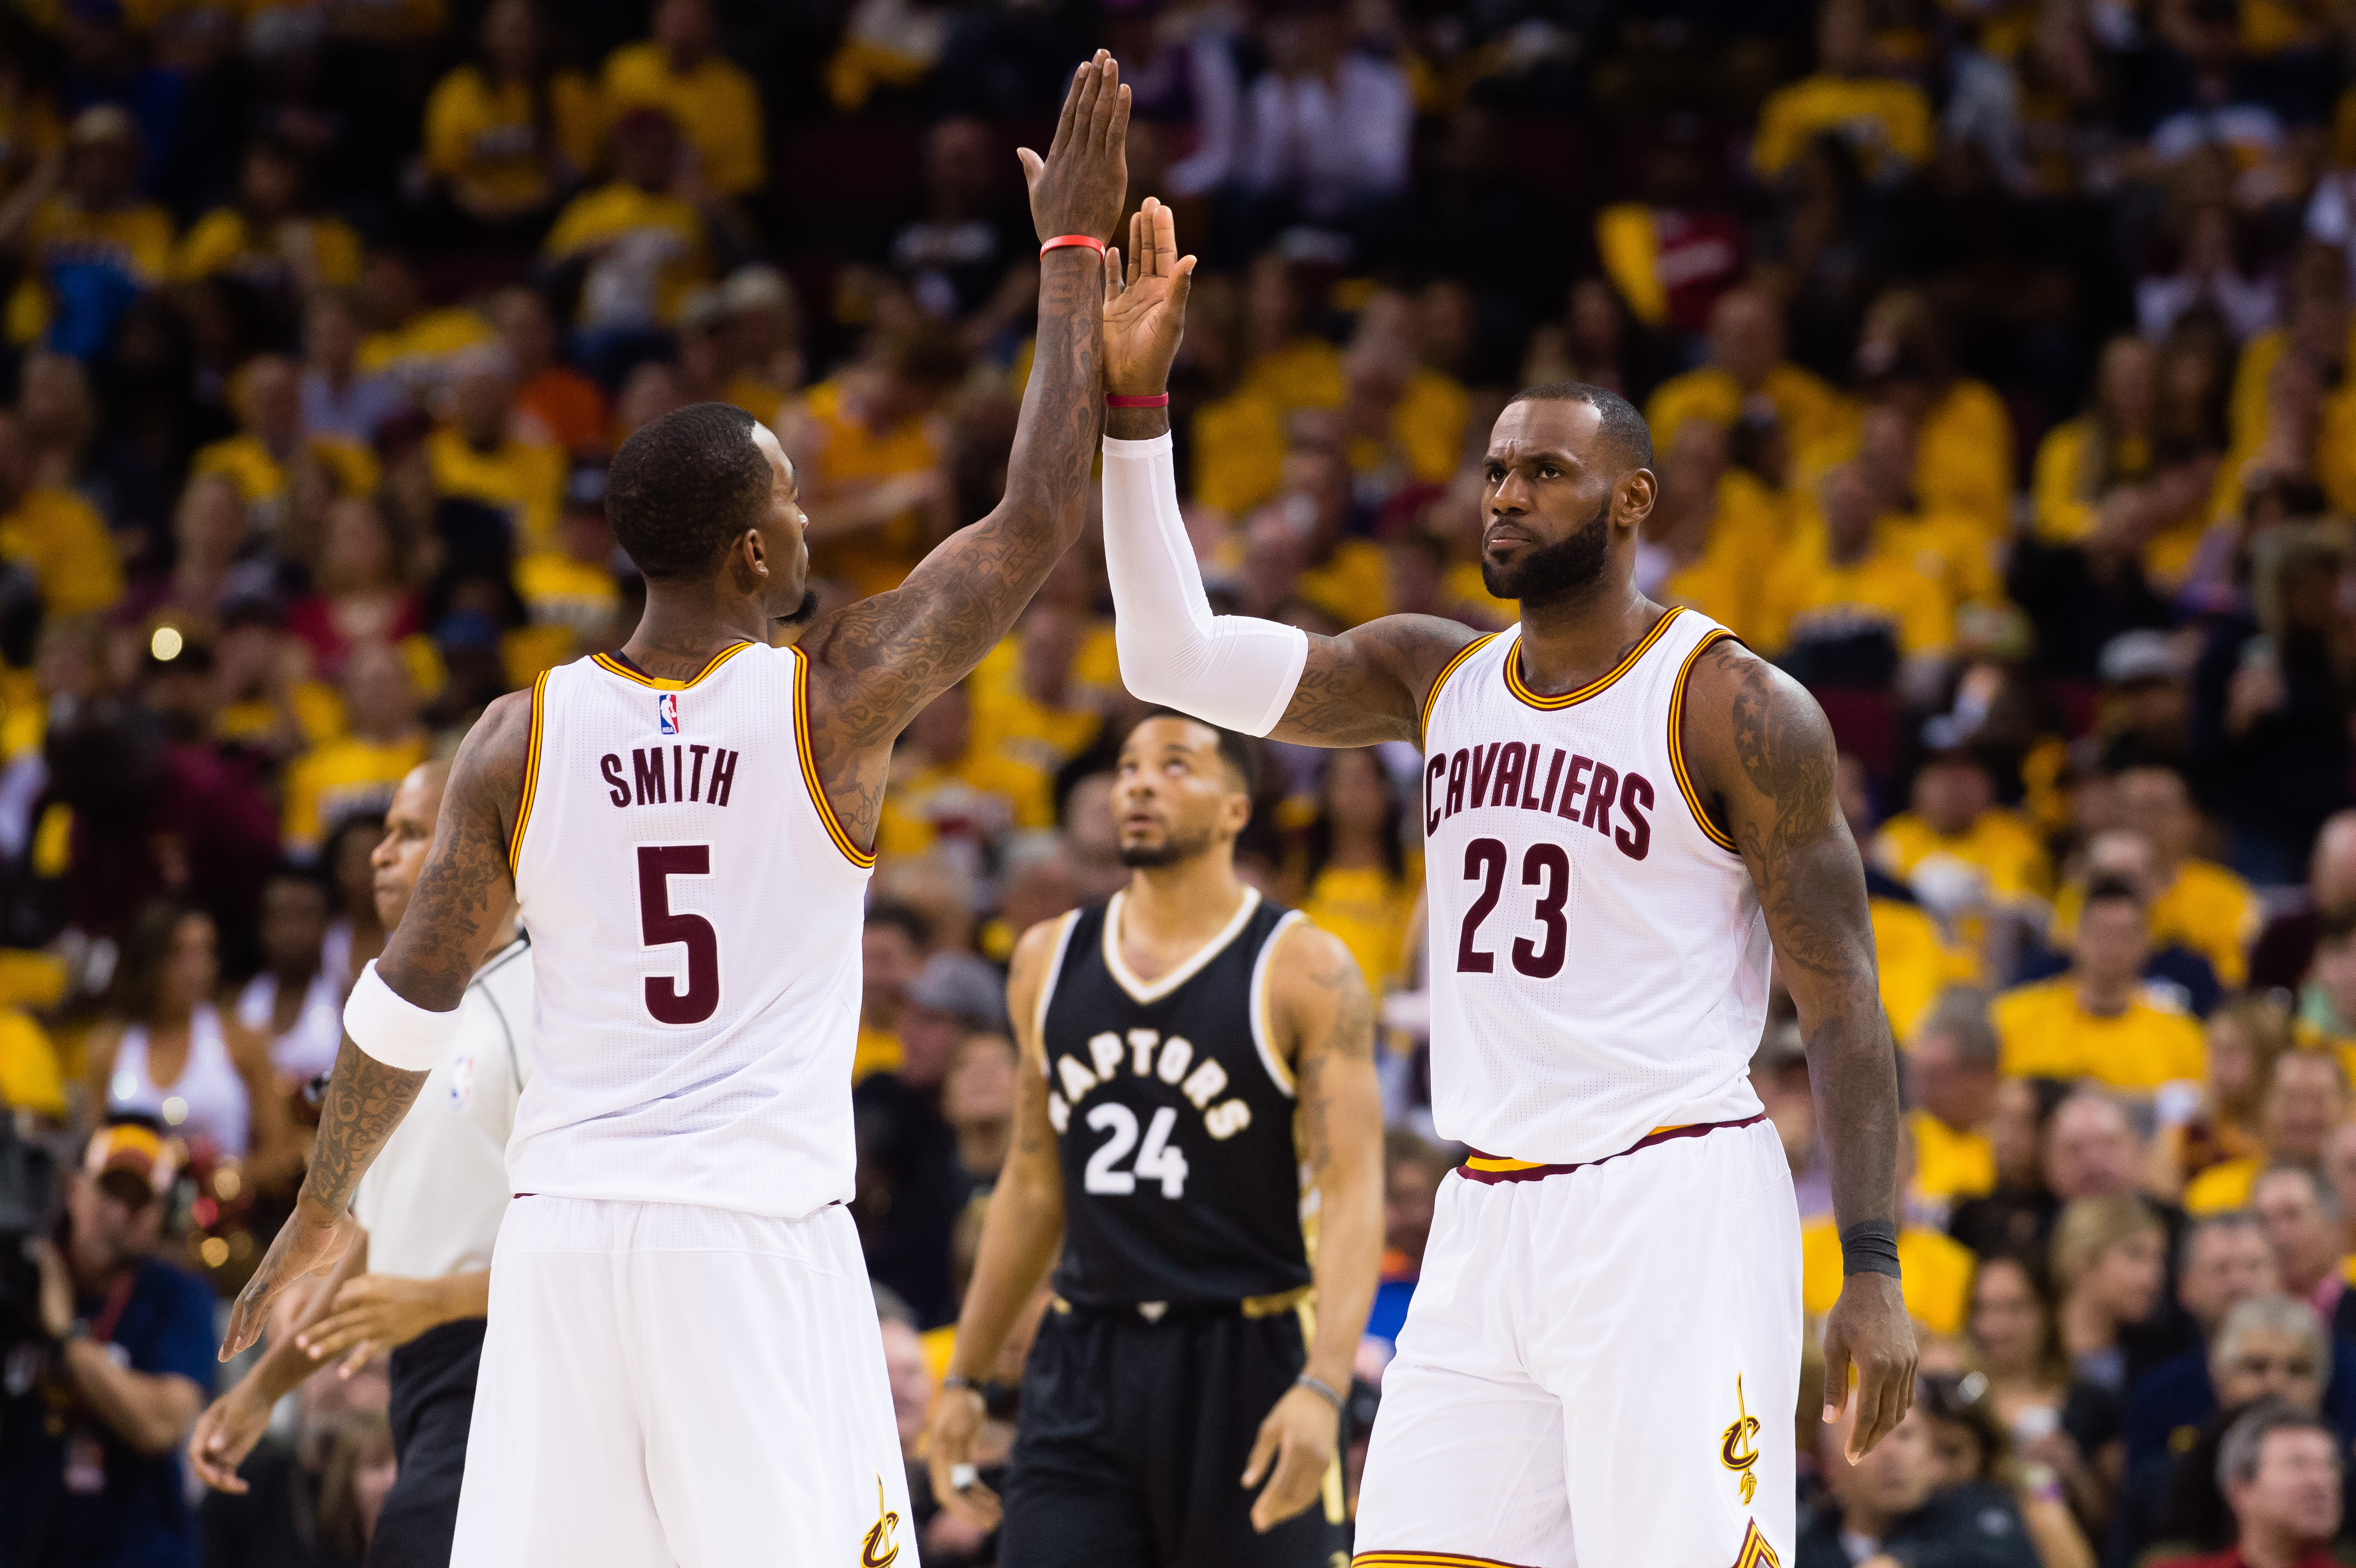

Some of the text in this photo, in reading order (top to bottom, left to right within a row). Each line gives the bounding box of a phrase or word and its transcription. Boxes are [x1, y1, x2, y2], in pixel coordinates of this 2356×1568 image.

[600, 744, 739, 808] SMITH
[1426, 741, 1655, 861] CAVALIERS
[637, 845, 720, 1024] 5
[1456, 838, 1570, 979] 23
[1084, 1101, 1189, 1200] 24
